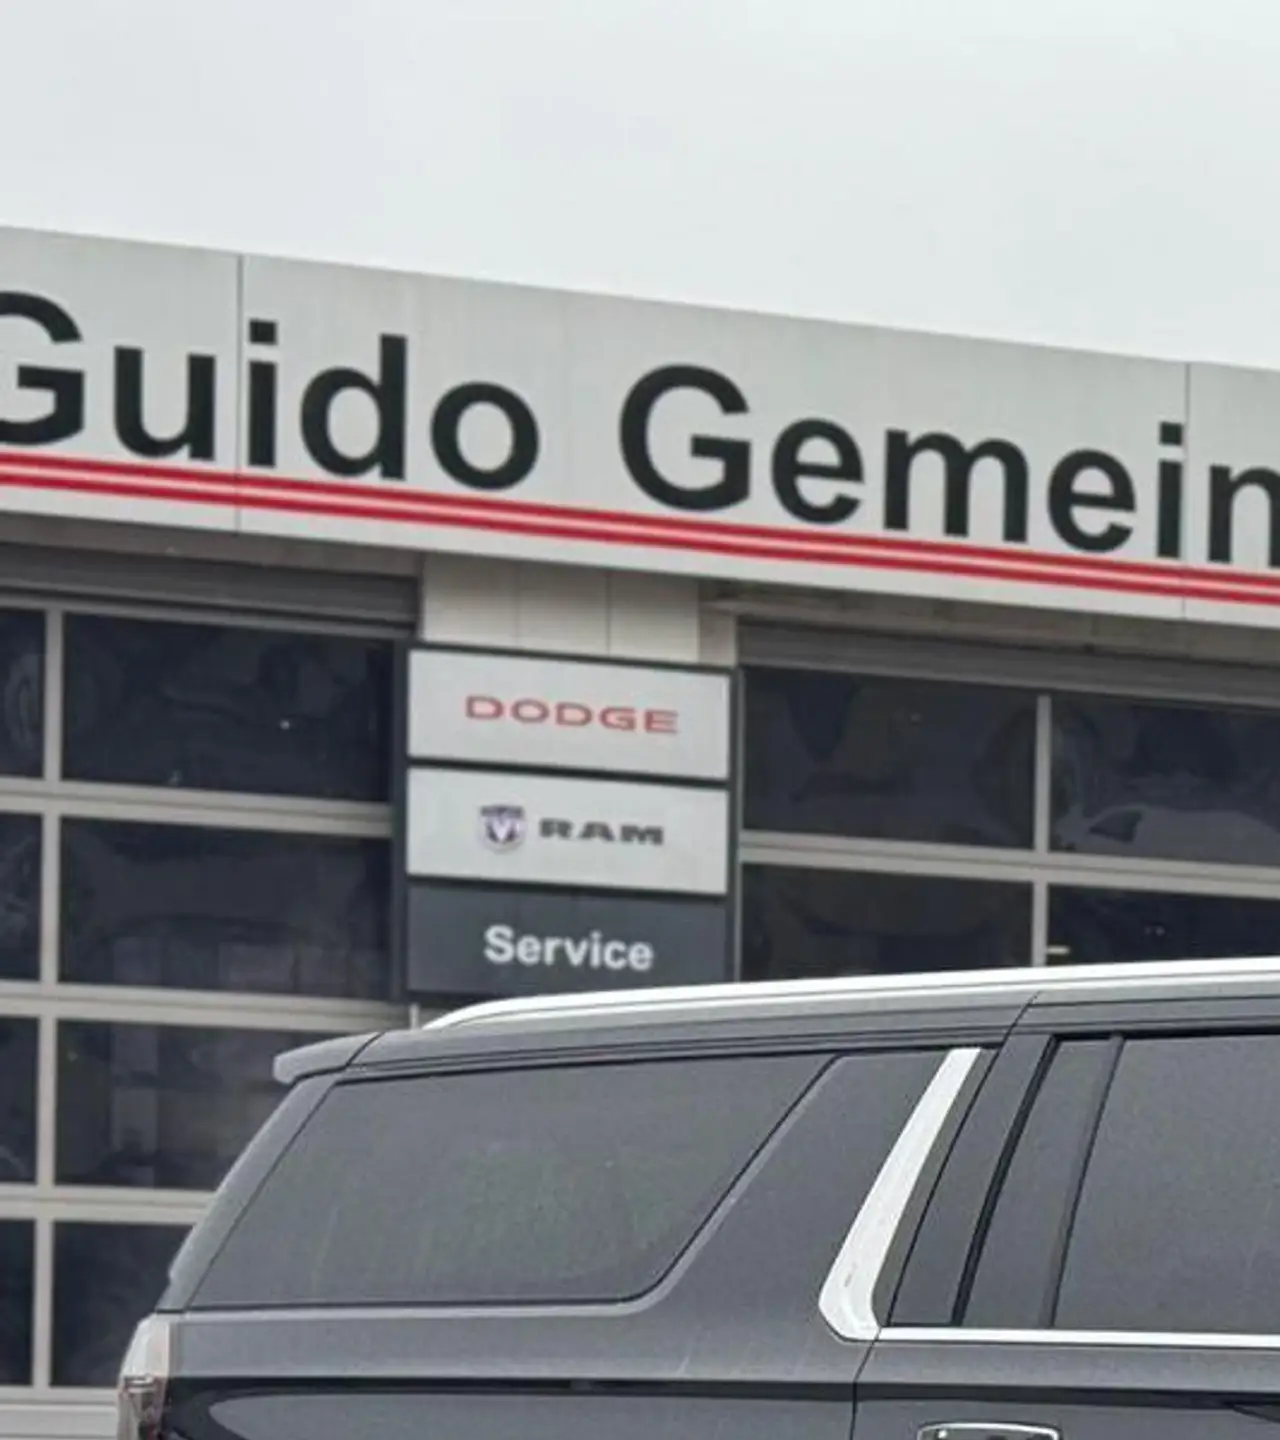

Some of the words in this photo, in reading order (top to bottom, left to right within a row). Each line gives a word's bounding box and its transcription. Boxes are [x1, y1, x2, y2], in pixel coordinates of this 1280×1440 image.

[0, 290, 540, 491] Guido
[465, 695, 679, 734] DODGE
[538, 817, 664, 846] RAM
[484, 924, 654, 970] Service
